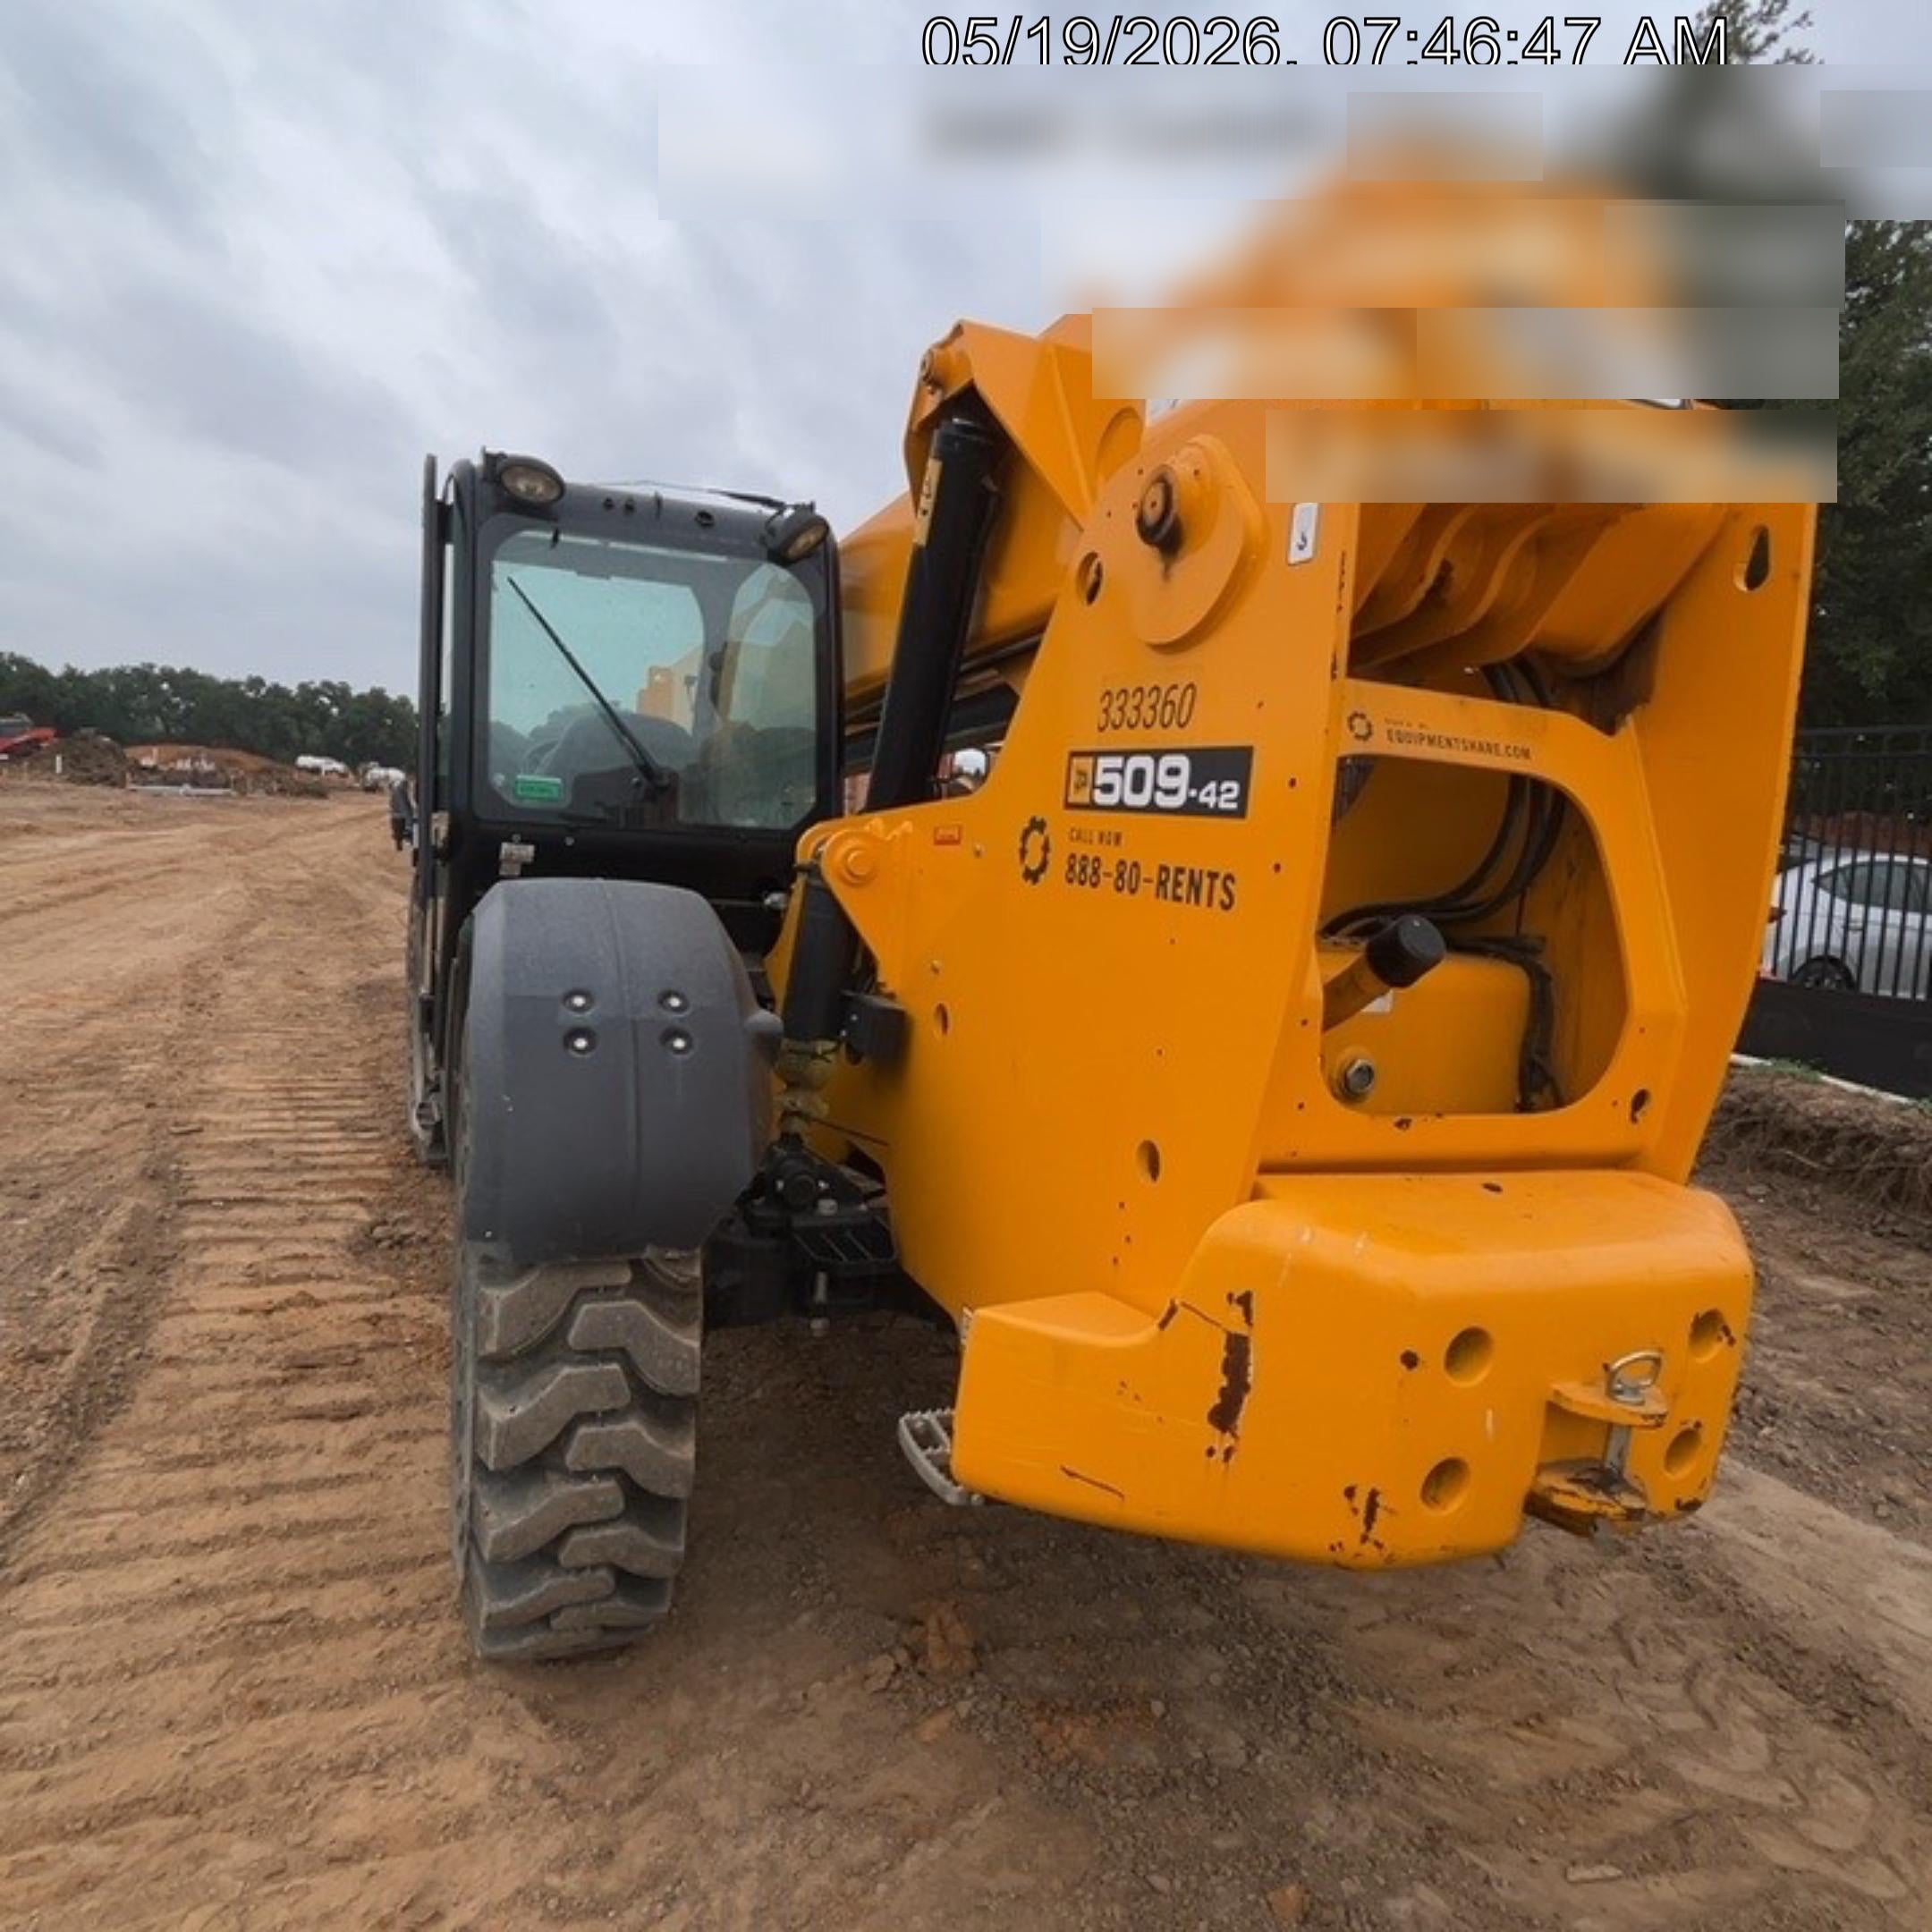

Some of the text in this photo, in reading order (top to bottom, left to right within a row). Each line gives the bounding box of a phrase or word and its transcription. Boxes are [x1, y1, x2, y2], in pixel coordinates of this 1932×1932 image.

[1097, 682, 1198, 733] 333360
[1069, 826, 1123, 847] CALL NOW
[1064, 852, 1237, 911] 888-80-RENTS
